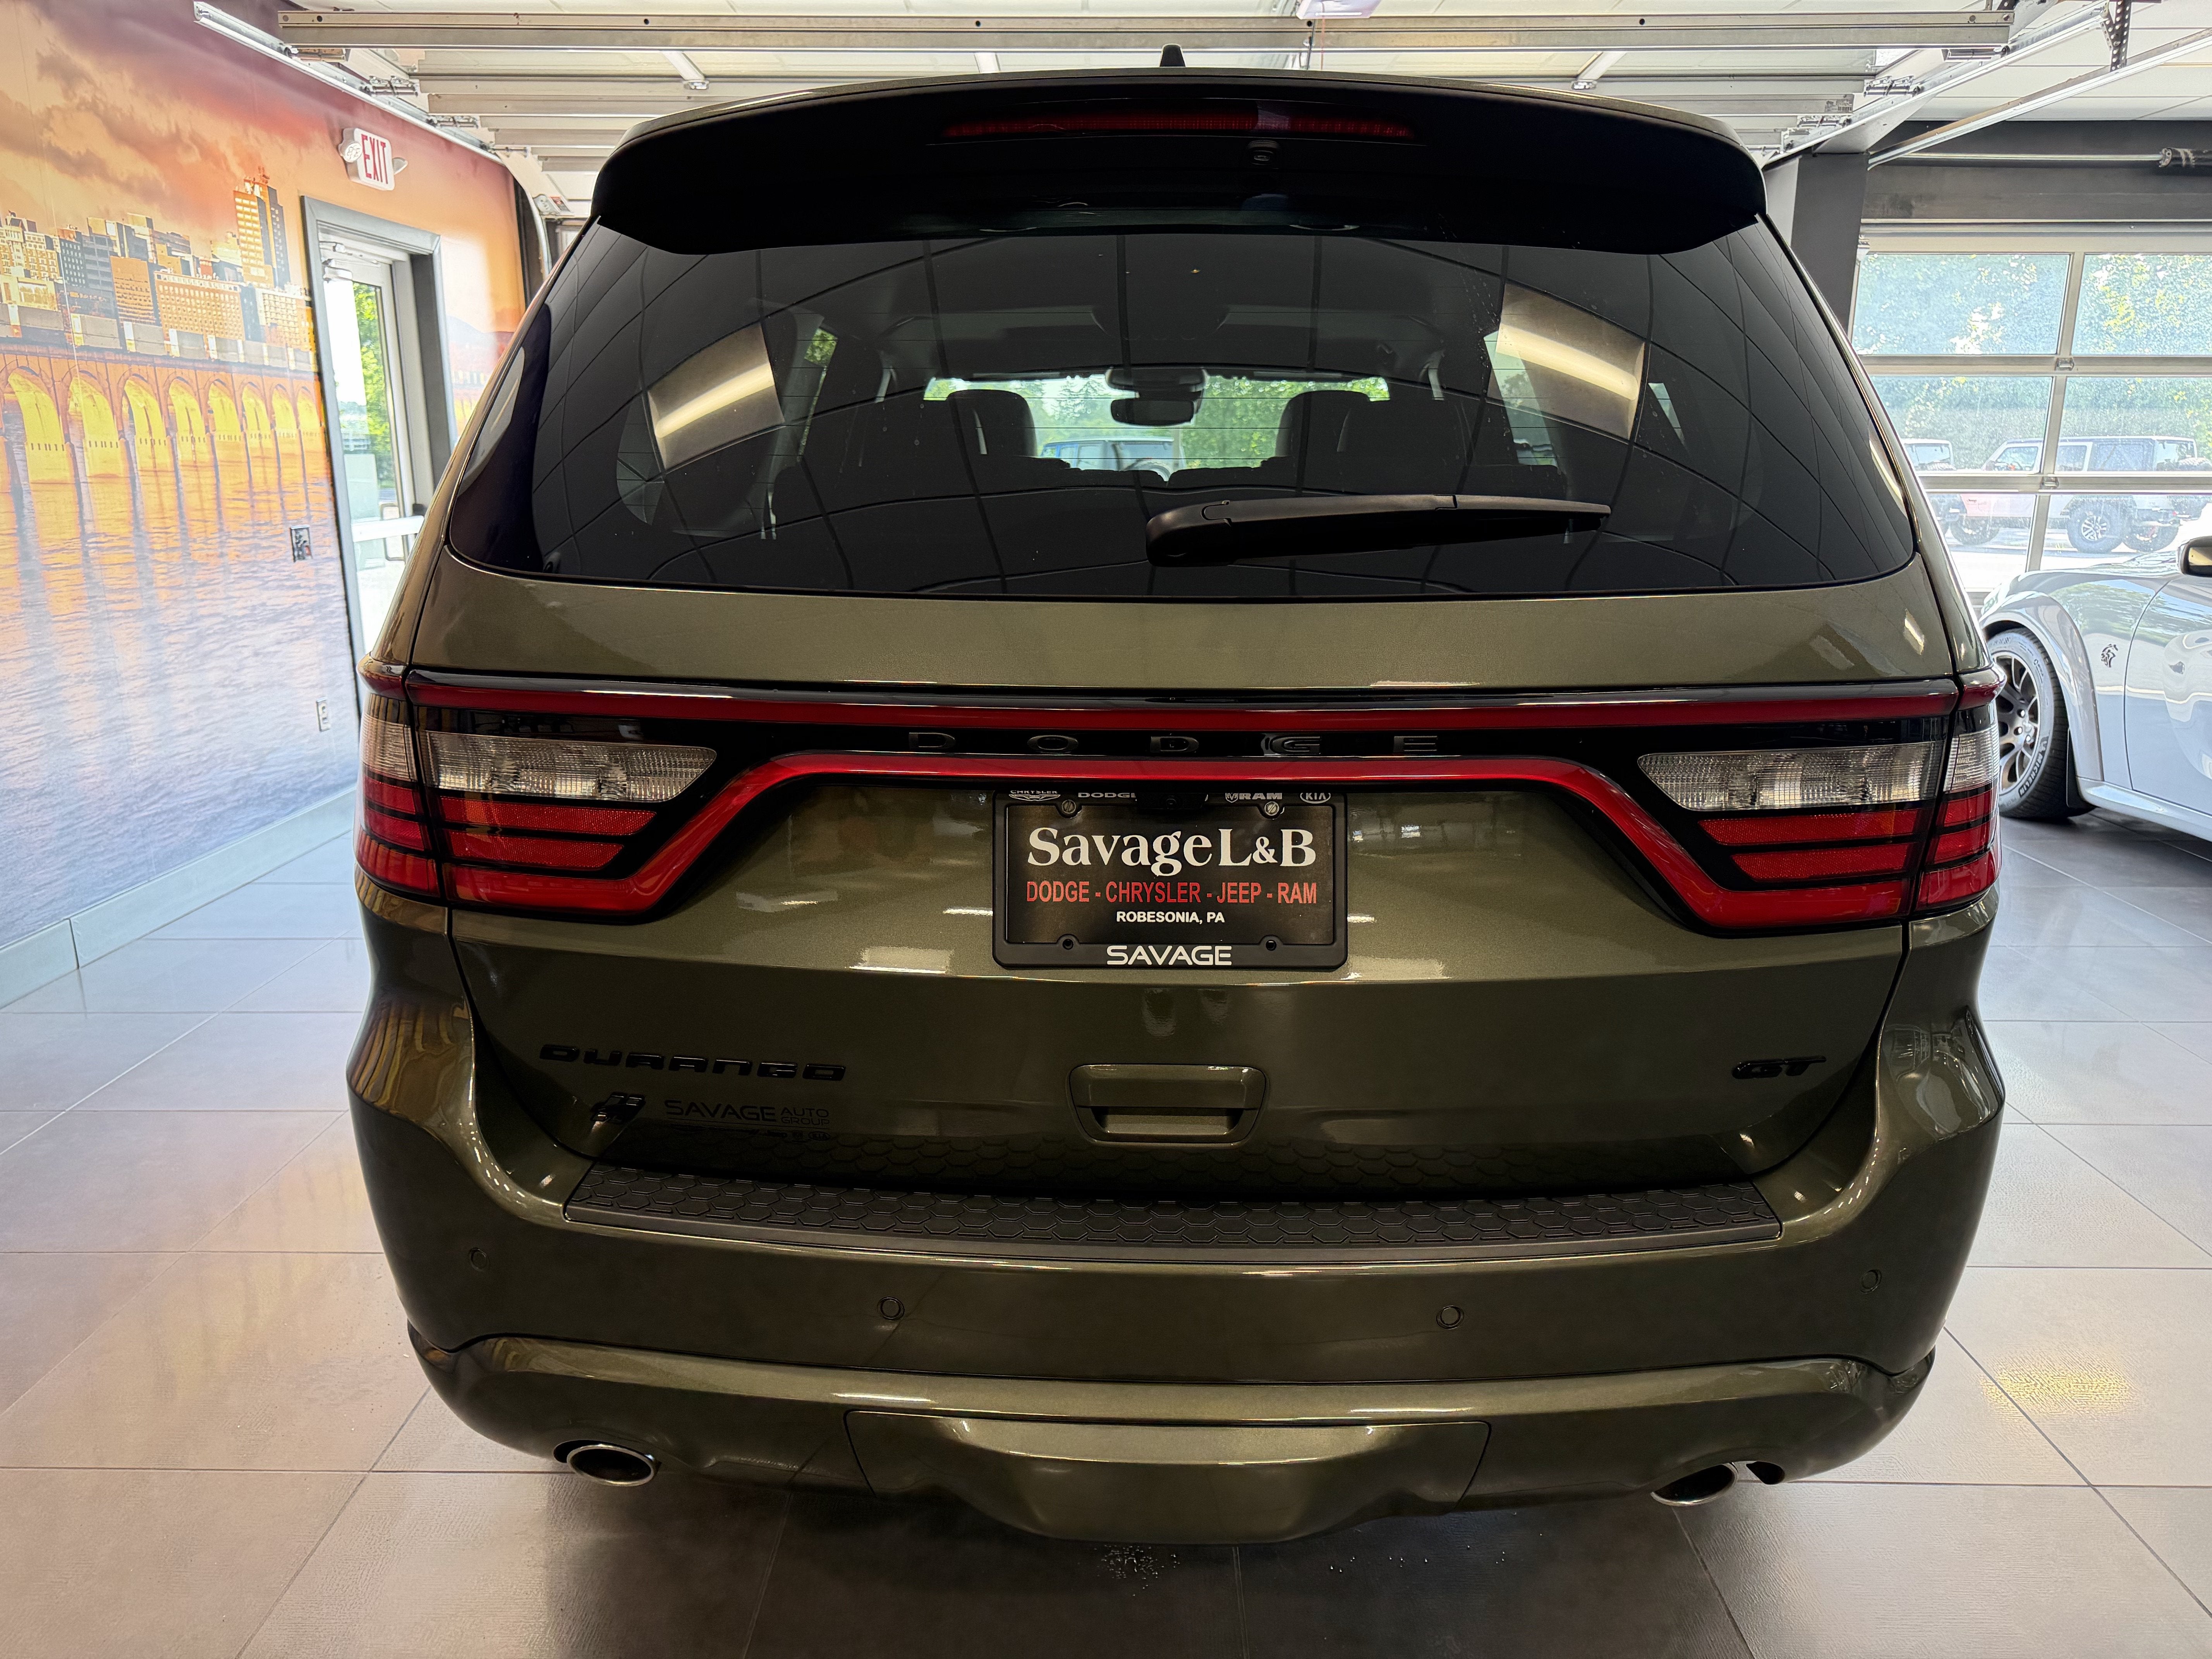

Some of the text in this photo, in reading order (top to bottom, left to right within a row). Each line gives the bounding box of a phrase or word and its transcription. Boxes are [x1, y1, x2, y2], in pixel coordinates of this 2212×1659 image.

[361, 134, 388, 184] EXIT
[908, 732, 1438, 755] DODGE
[2020, 752, 2043, 795] MICHELIN
[1027, 827, 1316, 876] Savage L&B
[1027, 881, 1090, 903] DODGE
[1106, 881, 1201, 904] CHRYSLER
[1216, 881, 1261, 904] JEEP
[1278, 882, 1317, 904] RAM
[1116, 911, 1224, 924] ROBESONIA, PA
[1107, 945, 1232, 966] SAVAGE
[539, 1044, 846, 1081] DURANGO
[1732, 1056, 1827, 1079] GT
[665, 1100, 829, 1122] SAVAGE AUTO
[781, 1116, 830, 1125] GROUP
